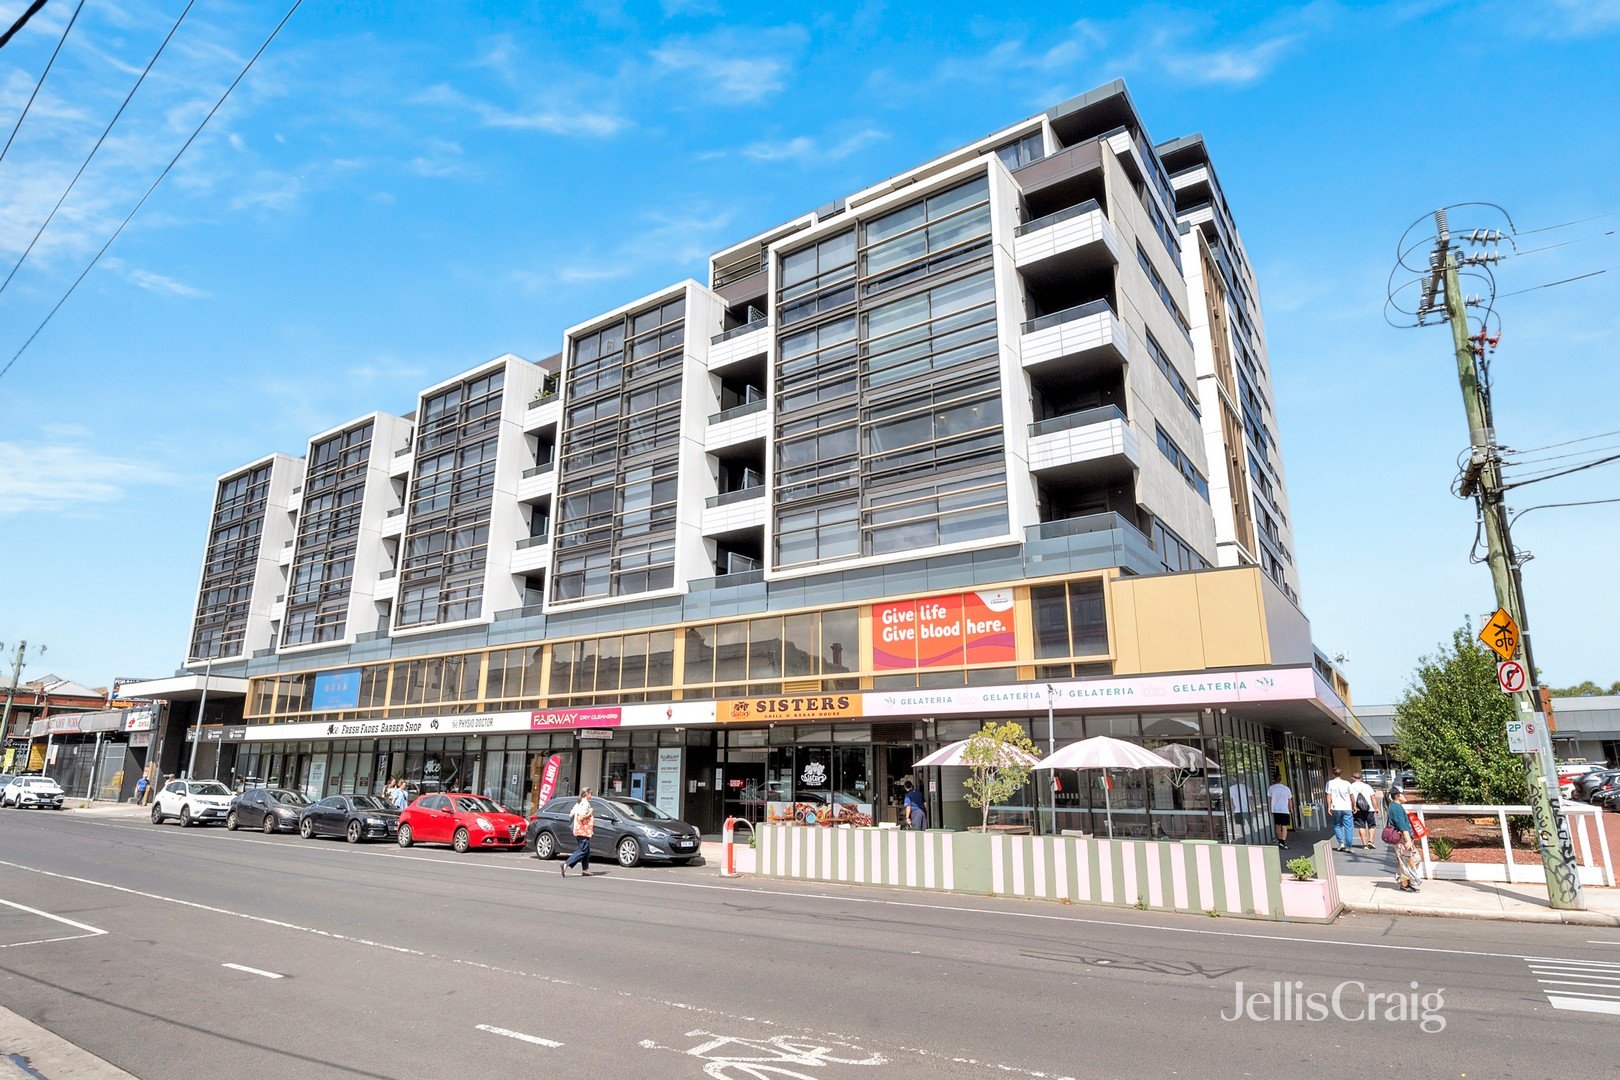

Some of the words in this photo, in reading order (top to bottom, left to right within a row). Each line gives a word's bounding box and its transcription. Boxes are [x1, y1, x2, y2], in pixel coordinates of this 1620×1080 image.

[881, 608, 914, 624] Give
[920, 603, 947, 620] life
[882, 625, 915, 643] Give
[920, 620, 960, 639] blood
[966, 618, 1007, 635] here.
[900, 696, 953, 706] GELATERIA
[983, 692, 1041, 702] GELATERIA
[1069, 687, 1135, 698] GELATERIA
[1173, 681, 1247, 693] GELATERIA
[756, 696, 849, 713] SISTERS
[341, 724, 360, 735] FRESH
[360, 723, 379, 733] FADES
[380, 722, 404, 732] BARBER
[404, 721, 422, 732] SHOP
[458, 719, 475, 729] PHYSIO
[475, 717, 494, 727] DOCTOR
[1508, 723, 1521, 733] 2P
[545, 764, 557, 784] DRY
